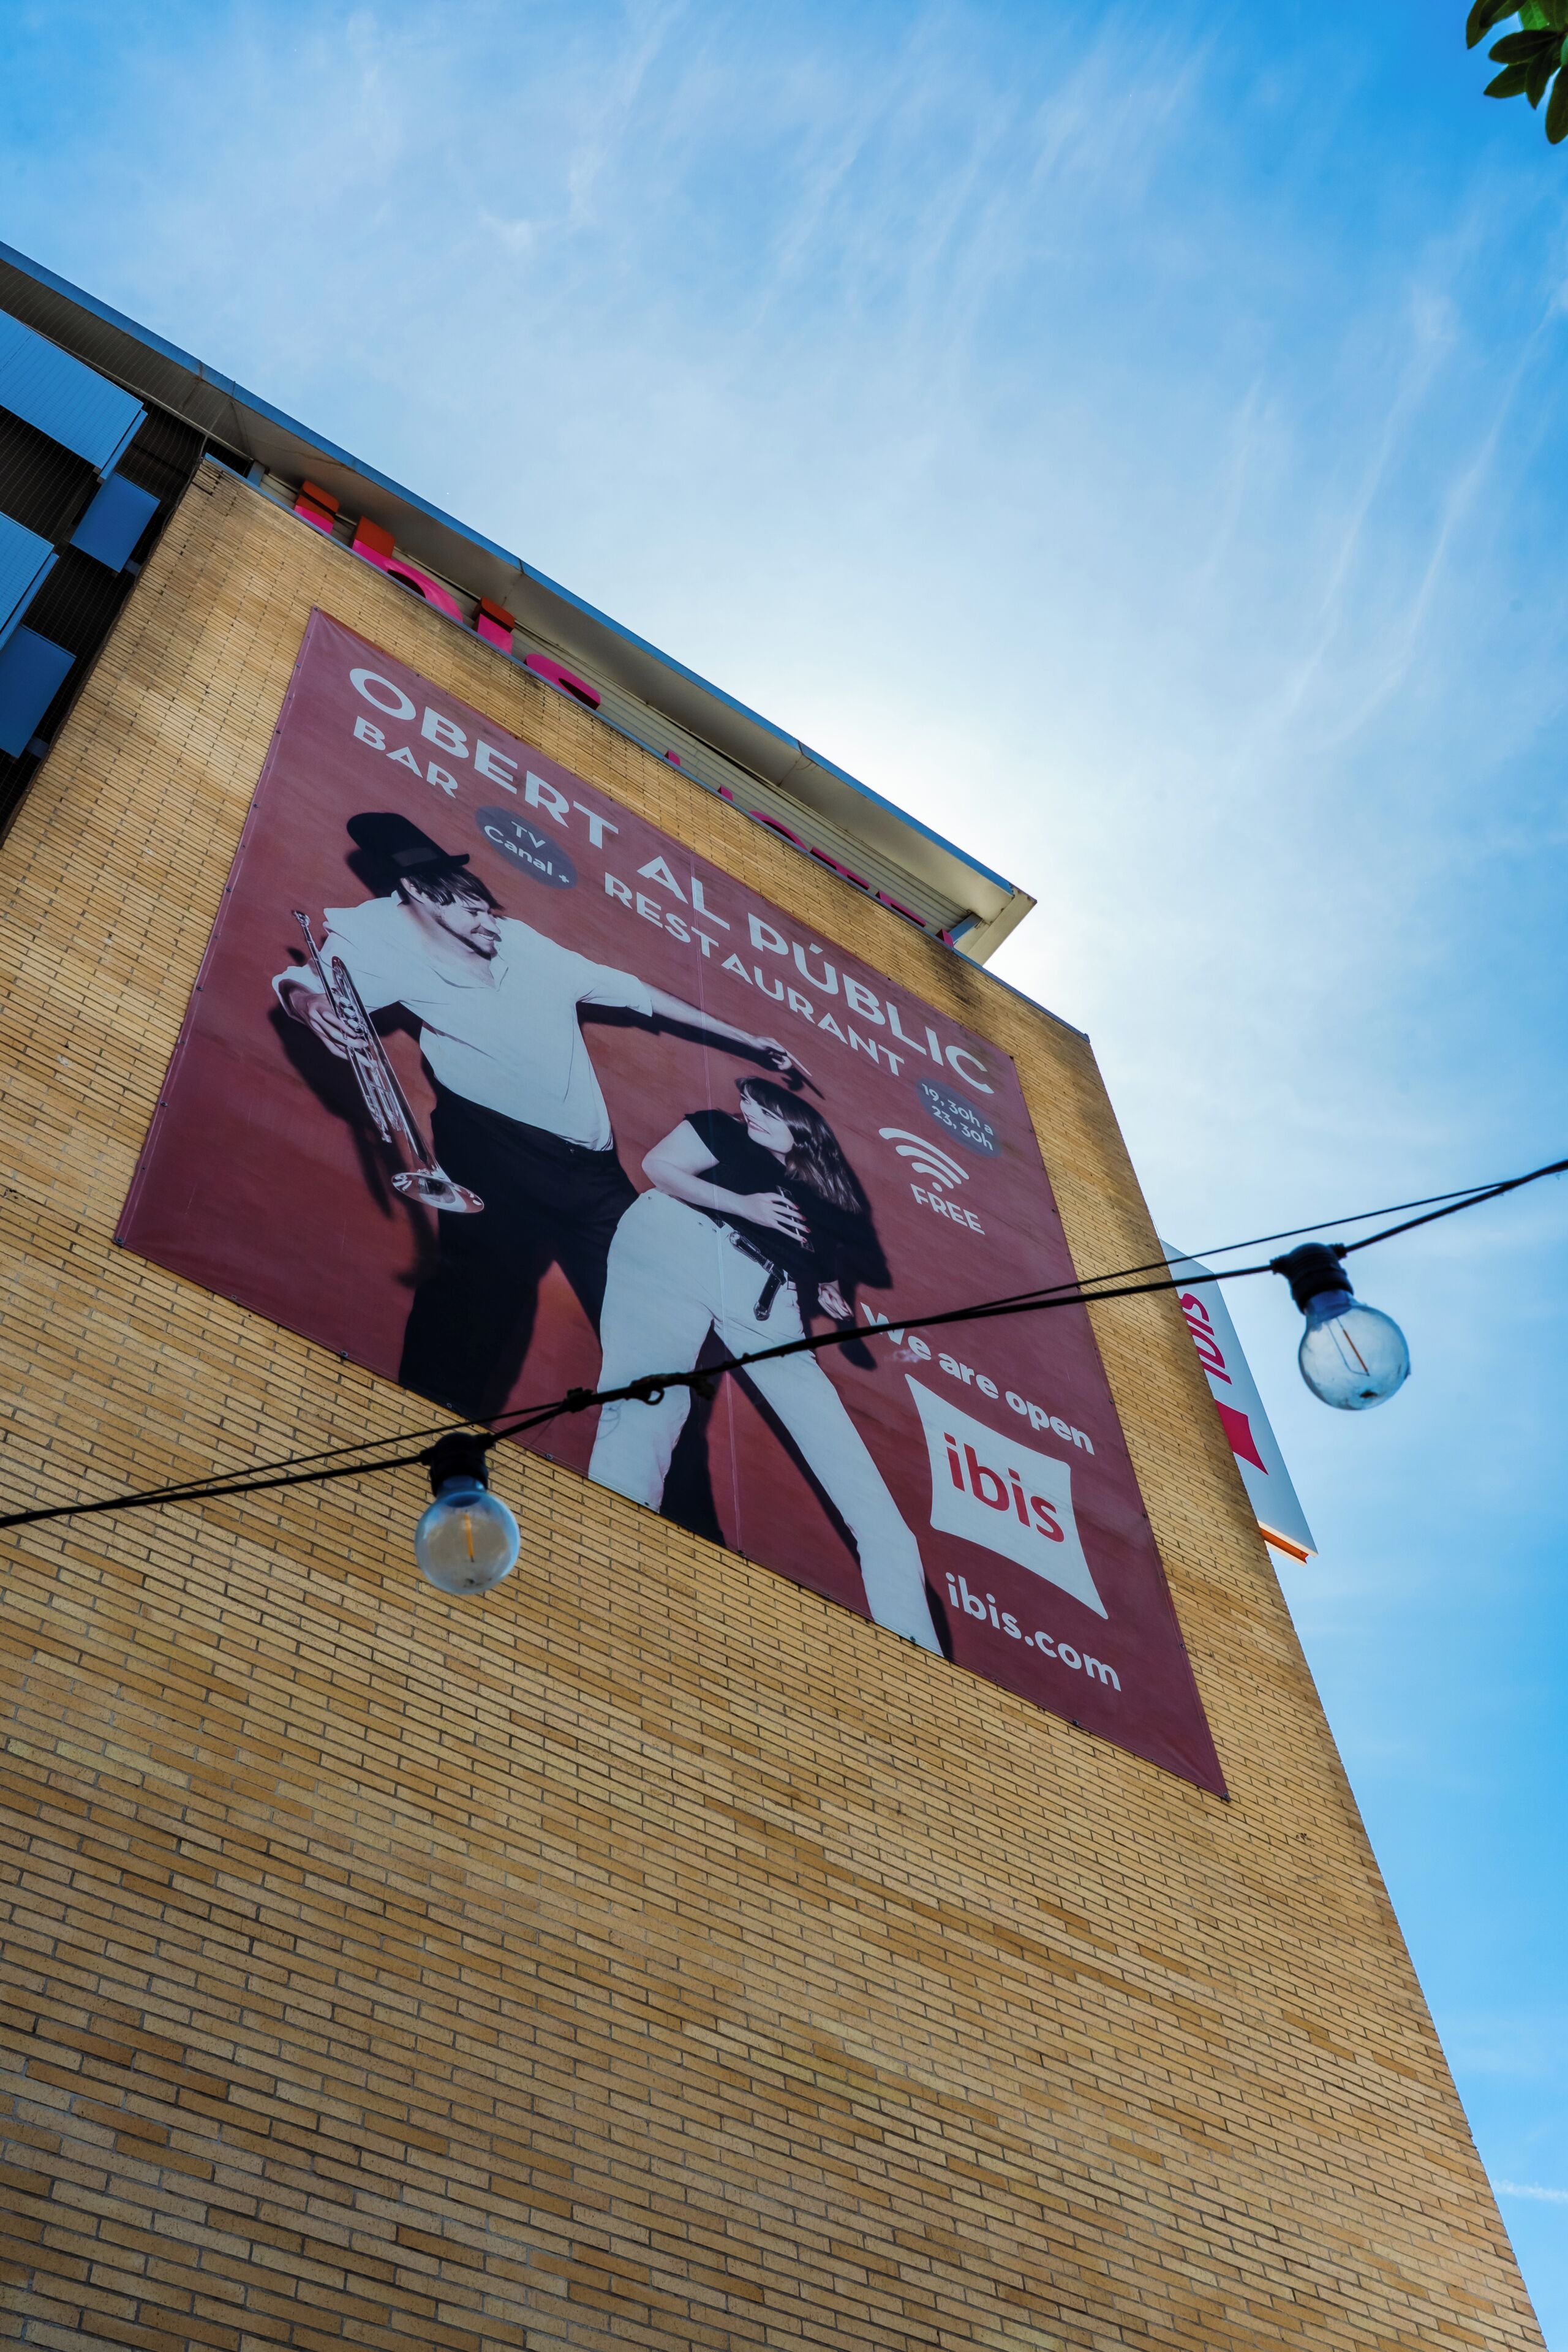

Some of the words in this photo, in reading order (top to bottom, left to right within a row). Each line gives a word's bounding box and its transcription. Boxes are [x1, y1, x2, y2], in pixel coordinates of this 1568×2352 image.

[353, 716, 458, 798] BAR
[349, 668, 619, 849] OBERT
[637, 856, 730, 930] AL
[748, 913, 995, 1094] PÚBLIC
[484, 825, 552, 876] Canal
[511, 821, 546, 848] TV
[605, 872, 905, 1076] RESTAURANT
[910, 1184, 985, 1235] FREE
[938, 1352, 999, 1400] are
[1005, 1390, 1095, 1455] open
[944, 1432, 1065, 1543] ibis
[945, 1572, 1122, 1692] ibis.com
